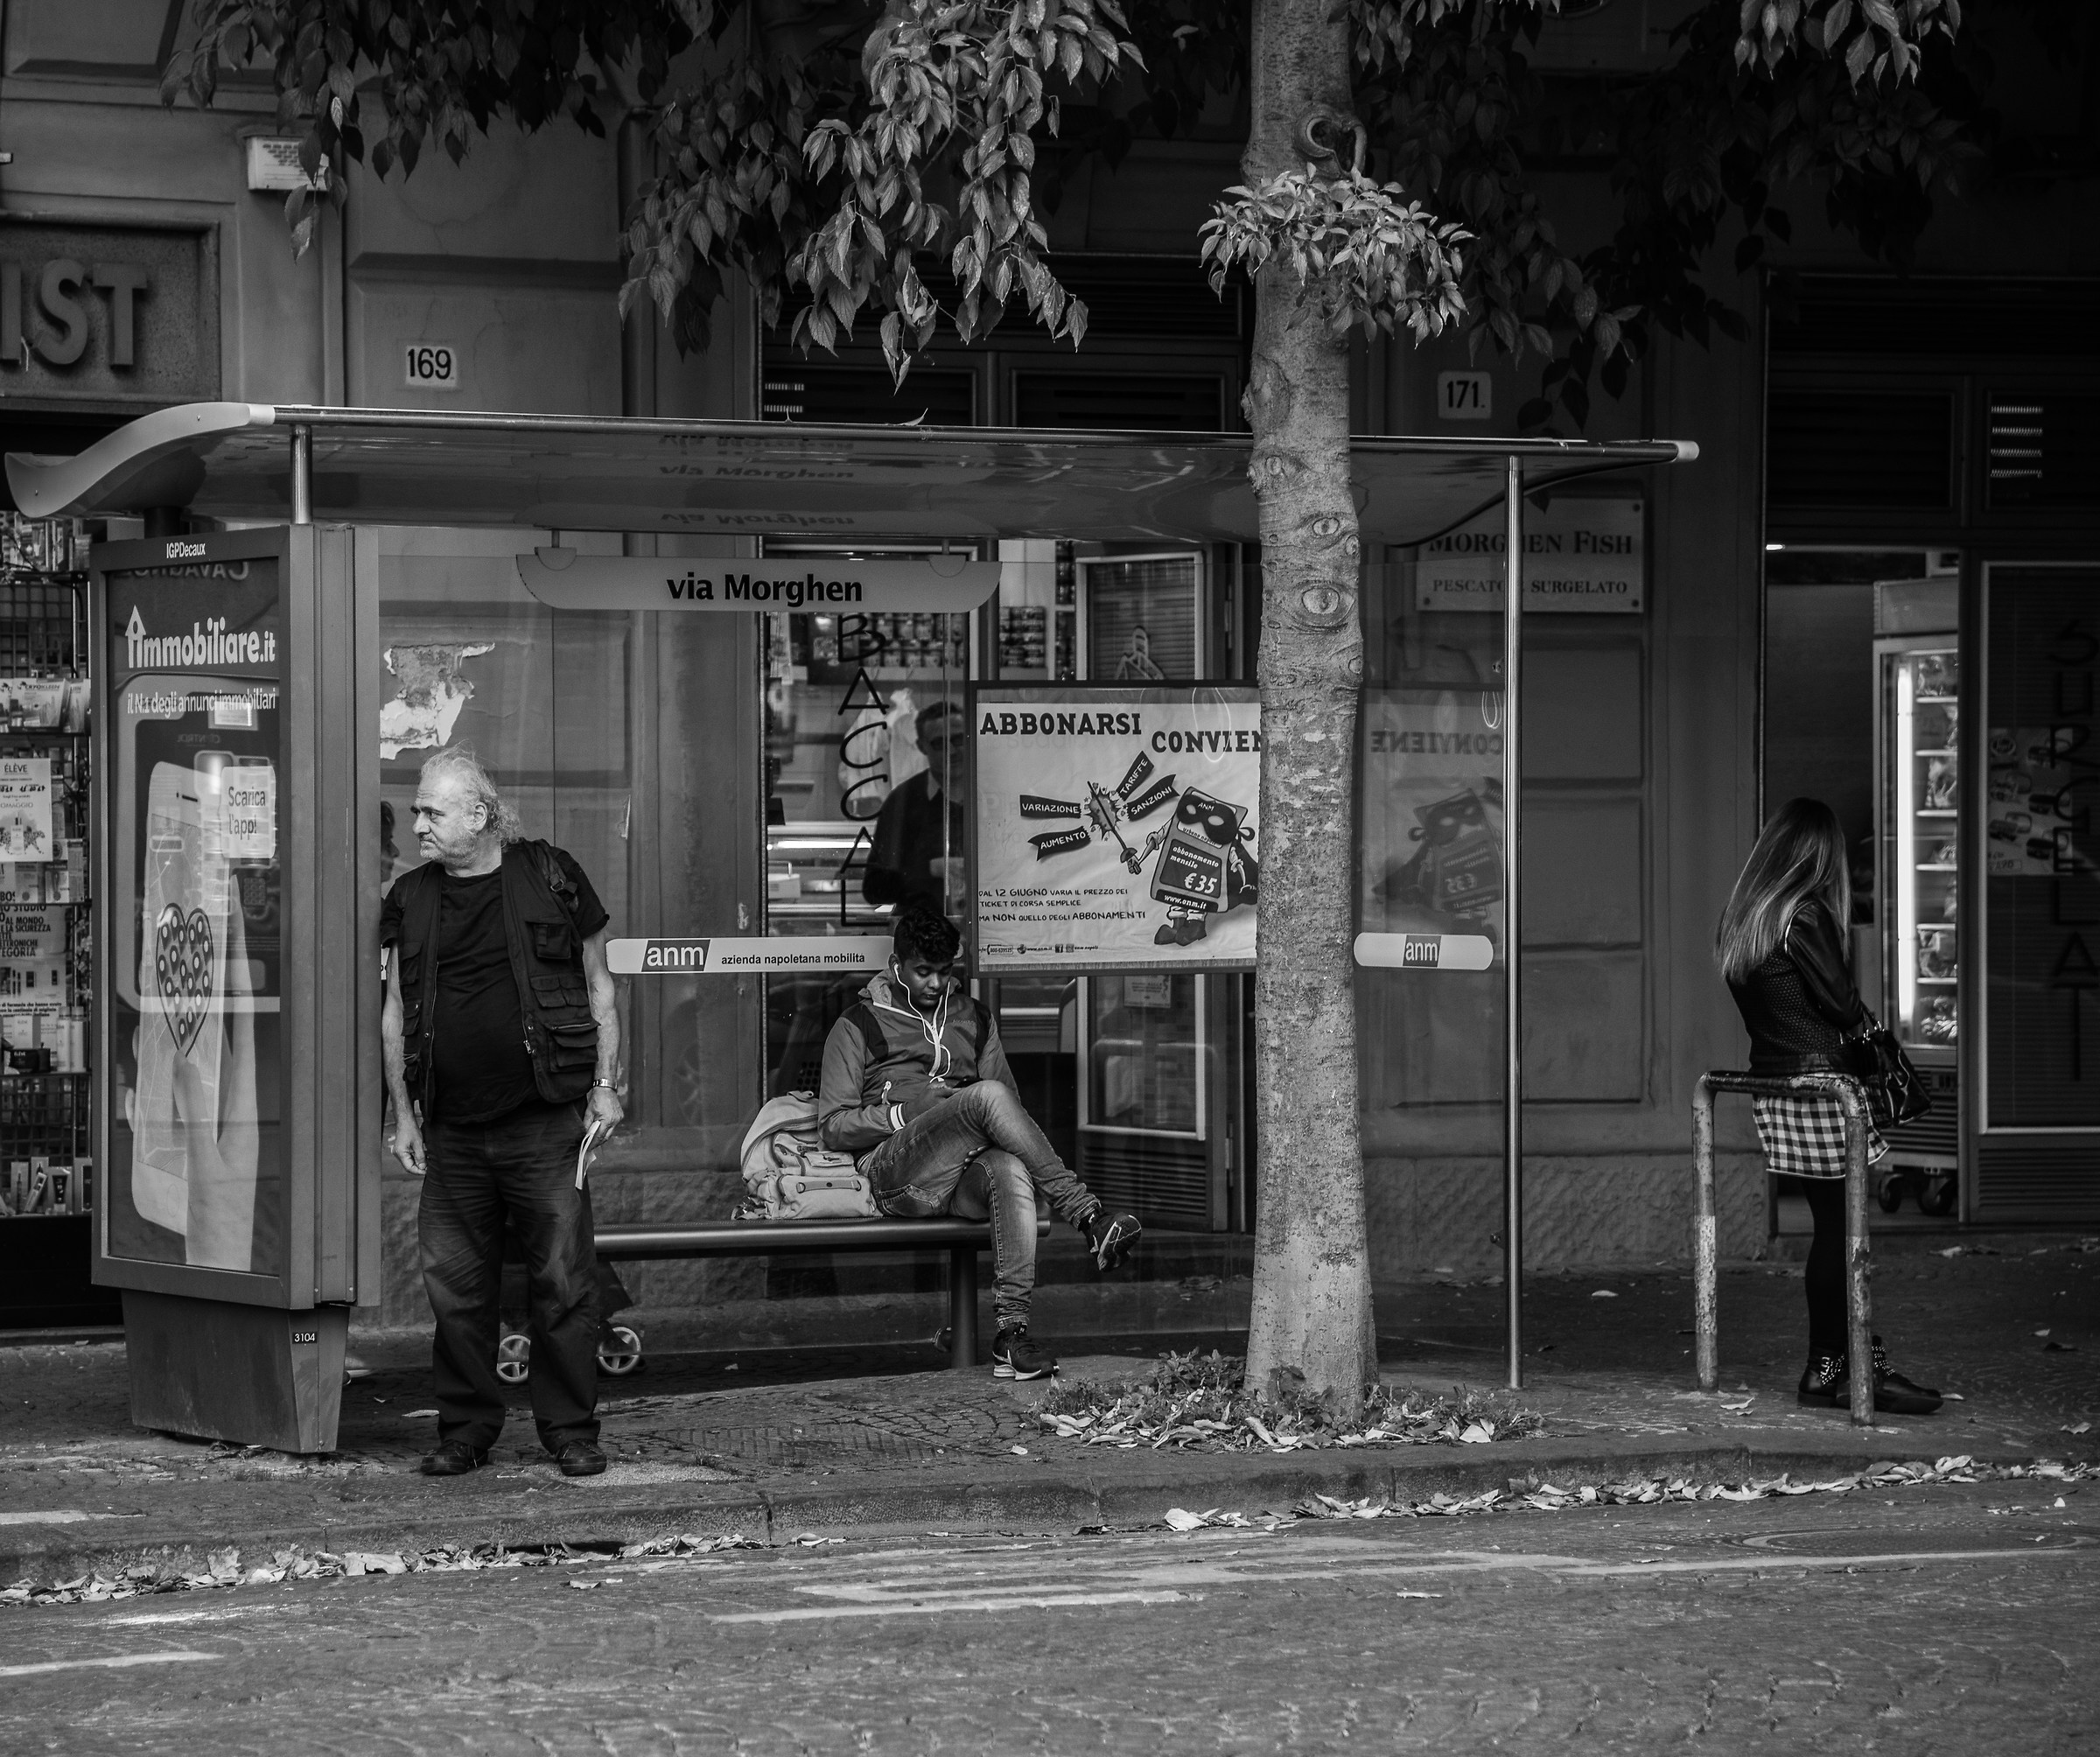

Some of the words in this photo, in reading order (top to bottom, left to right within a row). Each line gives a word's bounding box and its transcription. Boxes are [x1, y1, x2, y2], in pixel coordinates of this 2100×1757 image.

[408, 348, 452, 380] 169
[166, 542, 206, 559] IGPDecaux
[1574, 530, 1634, 555] FISH
[667, 571, 714, 600] via
[724, 573, 864, 608] Morghen
[1530, 580, 1628, 594] SURGELATO
[128, 693, 134, 714] il
[151, 691, 177, 718] degli
[178, 690, 218, 712] annunci
[219, 687, 276, 711] immobiliari
[979, 712, 1142, 735] ABBONARSI
[4, 763, 28, 773] ÉLÈVE
[1119, 758, 1148, 794] TARIFFE
[228, 786, 266, 807] Scarica
[1130, 786, 1172, 815] SANZIONI
[1022, 802, 1080, 814] VARIAZIONE
[1197, 802, 1214, 812] ANM
[1040, 830, 1087, 850] AUMENTO
[1170, 854, 1199, 869] mensile
[1172, 846, 1219, 867] abbonamento
[995, 888, 1006, 897] 12
[1010, 888, 1047, 897] GIUGNO
[1164, 894, 1208, 909] www.anm.it
[16, 916, 44, 925] MONDO
[1072, 911, 1145, 920] ABBONAMENTI
[646, 945, 704, 967] anm
[721, 955, 761, 965] azienda
[764, 954, 821, 966] napoletana
[1404, 941, 1439, 962] anm
[294, 1333, 316, 1342] 3104
